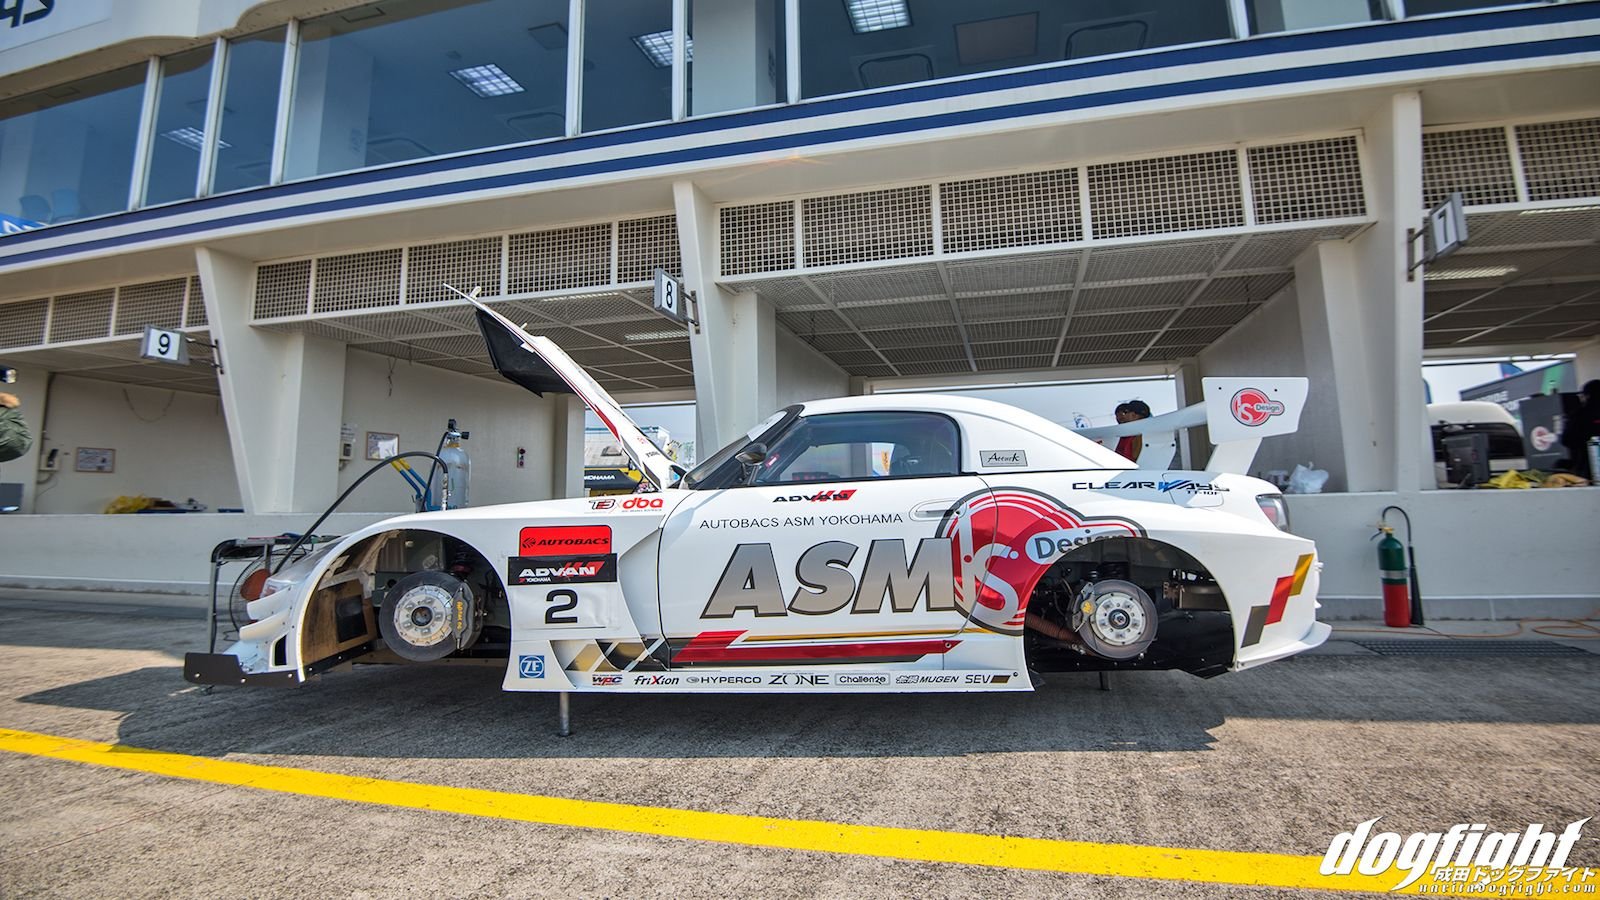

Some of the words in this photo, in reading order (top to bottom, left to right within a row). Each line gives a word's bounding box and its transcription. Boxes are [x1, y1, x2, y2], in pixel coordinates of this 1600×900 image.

[1437, 209, 1449, 244] 7
[665, 281, 673, 309] 8
[158, 333, 170, 355] 9
[1255, 403, 1280, 413] Design
[772, 490, 850, 503] ADVAN
[622, 497, 664, 509] dba
[699, 517, 779, 529] AUTOBACS
[783, 515, 815, 527] ASM
[819, 513, 903, 525] YOKOHAMA
[537, 537, 609, 546] AUTOBACS
[518, 566, 596, 577] ADVAN
[699, 537, 956, 619] ASM
[544, 589, 578, 624] 2
[522, 658, 540, 673] ZF
[701, 676, 762, 684] HYPERCO
[768, 674, 829, 686] ZONE
[919, 675, 960, 684] MUGEN
[965, 674, 991, 684] SEV
